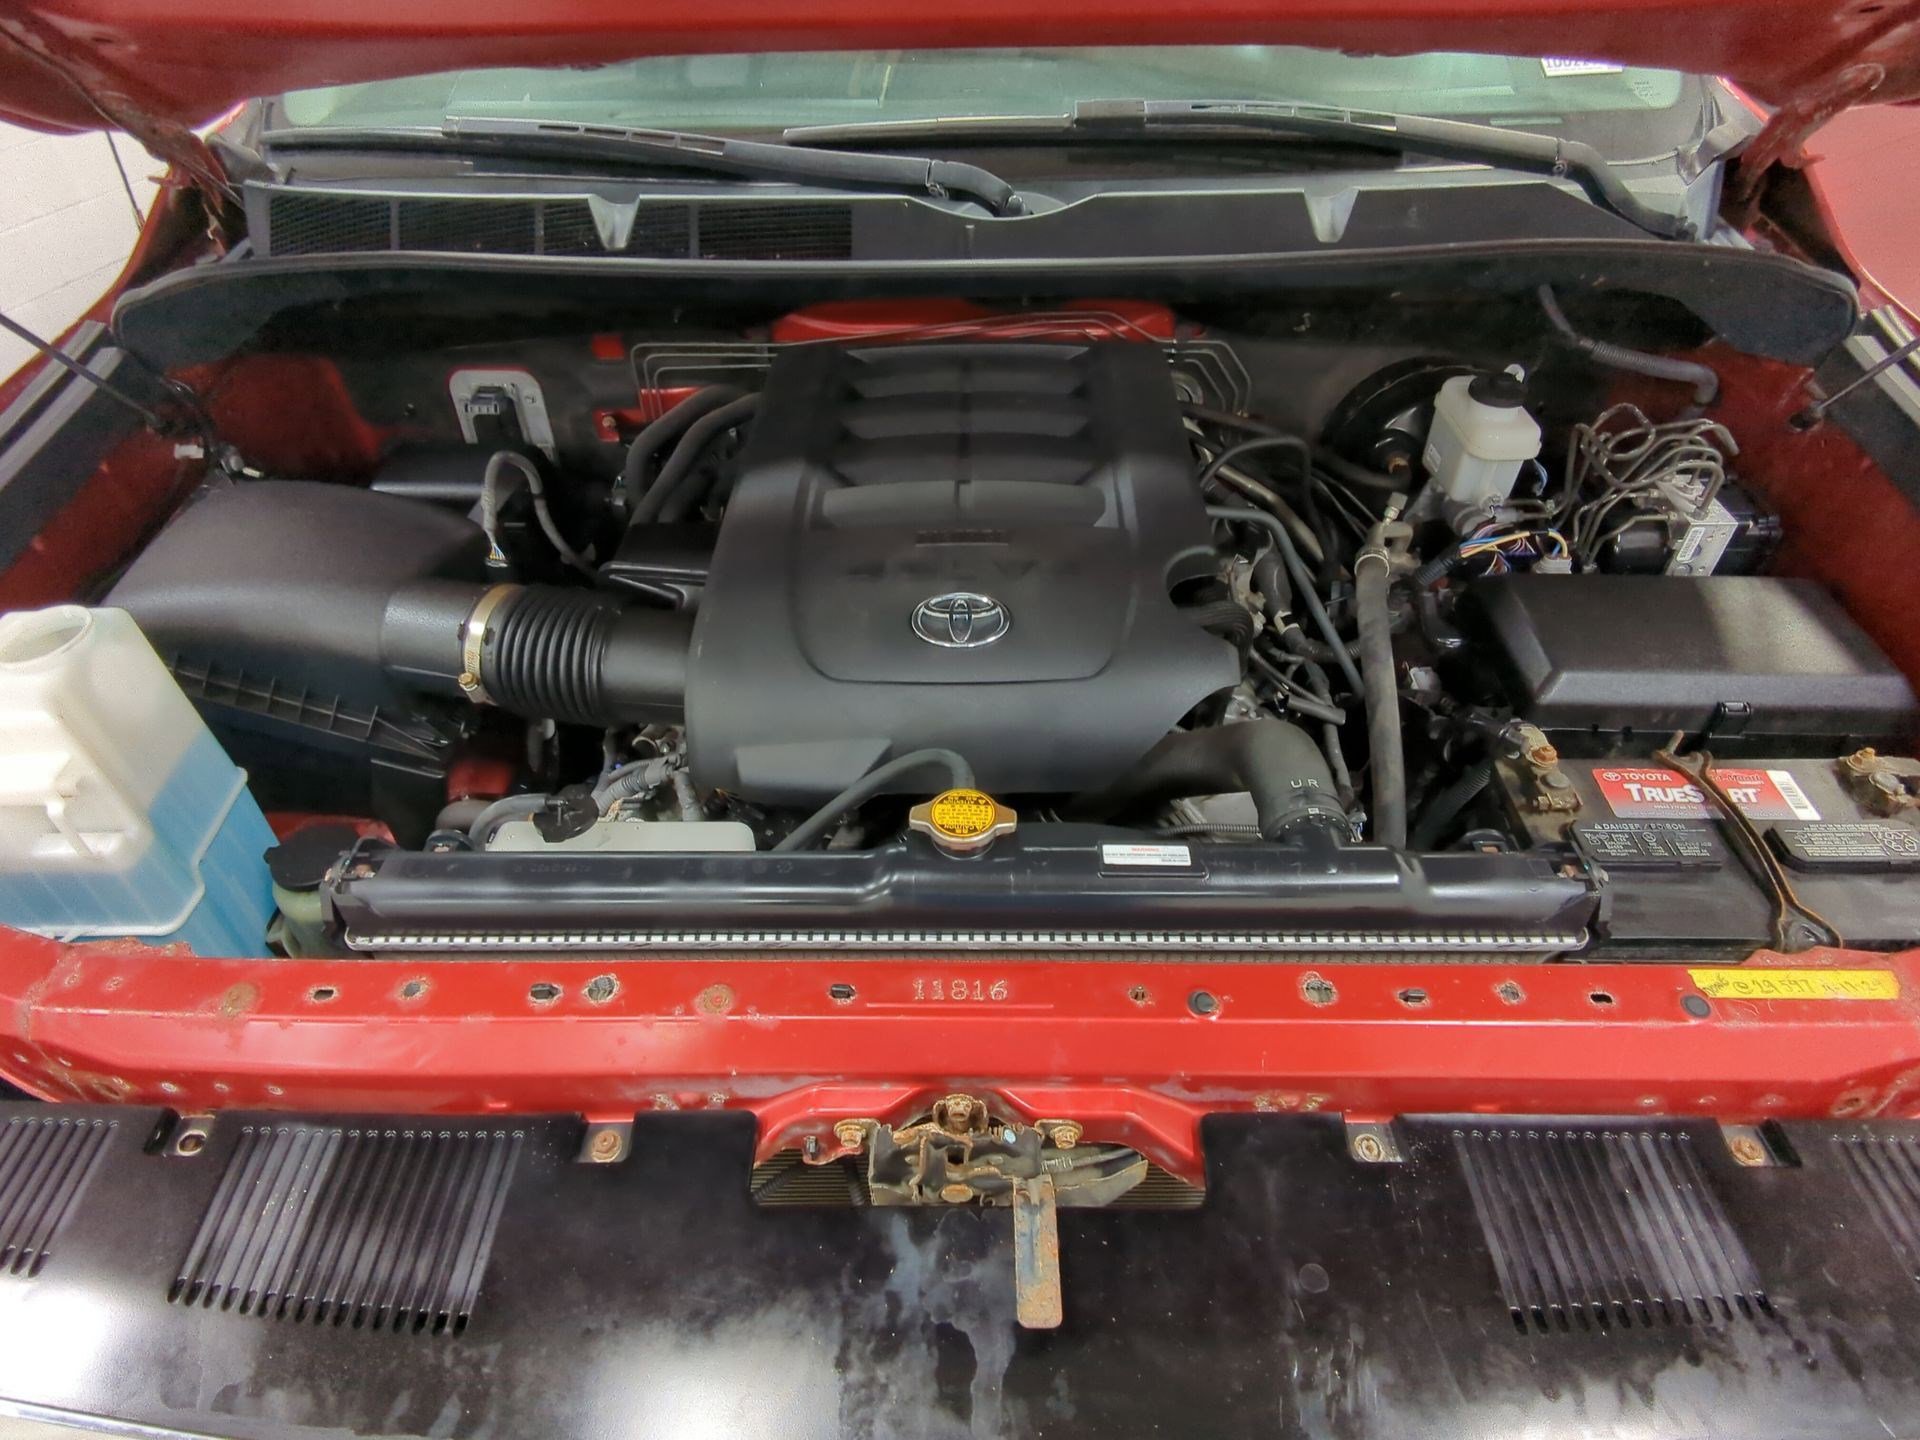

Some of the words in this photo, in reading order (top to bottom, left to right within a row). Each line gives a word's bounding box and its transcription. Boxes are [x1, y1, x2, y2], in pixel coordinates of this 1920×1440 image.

[1621, 772, 1672, 782] TOYOTA
[1290, 779, 1302, 788] U
[1308, 778, 1320, 788] R
[1602, 822, 1641, 830] DANGER
[1650, 822, 1686, 830] POISON
[911, 978, 1008, 1001] 11816
